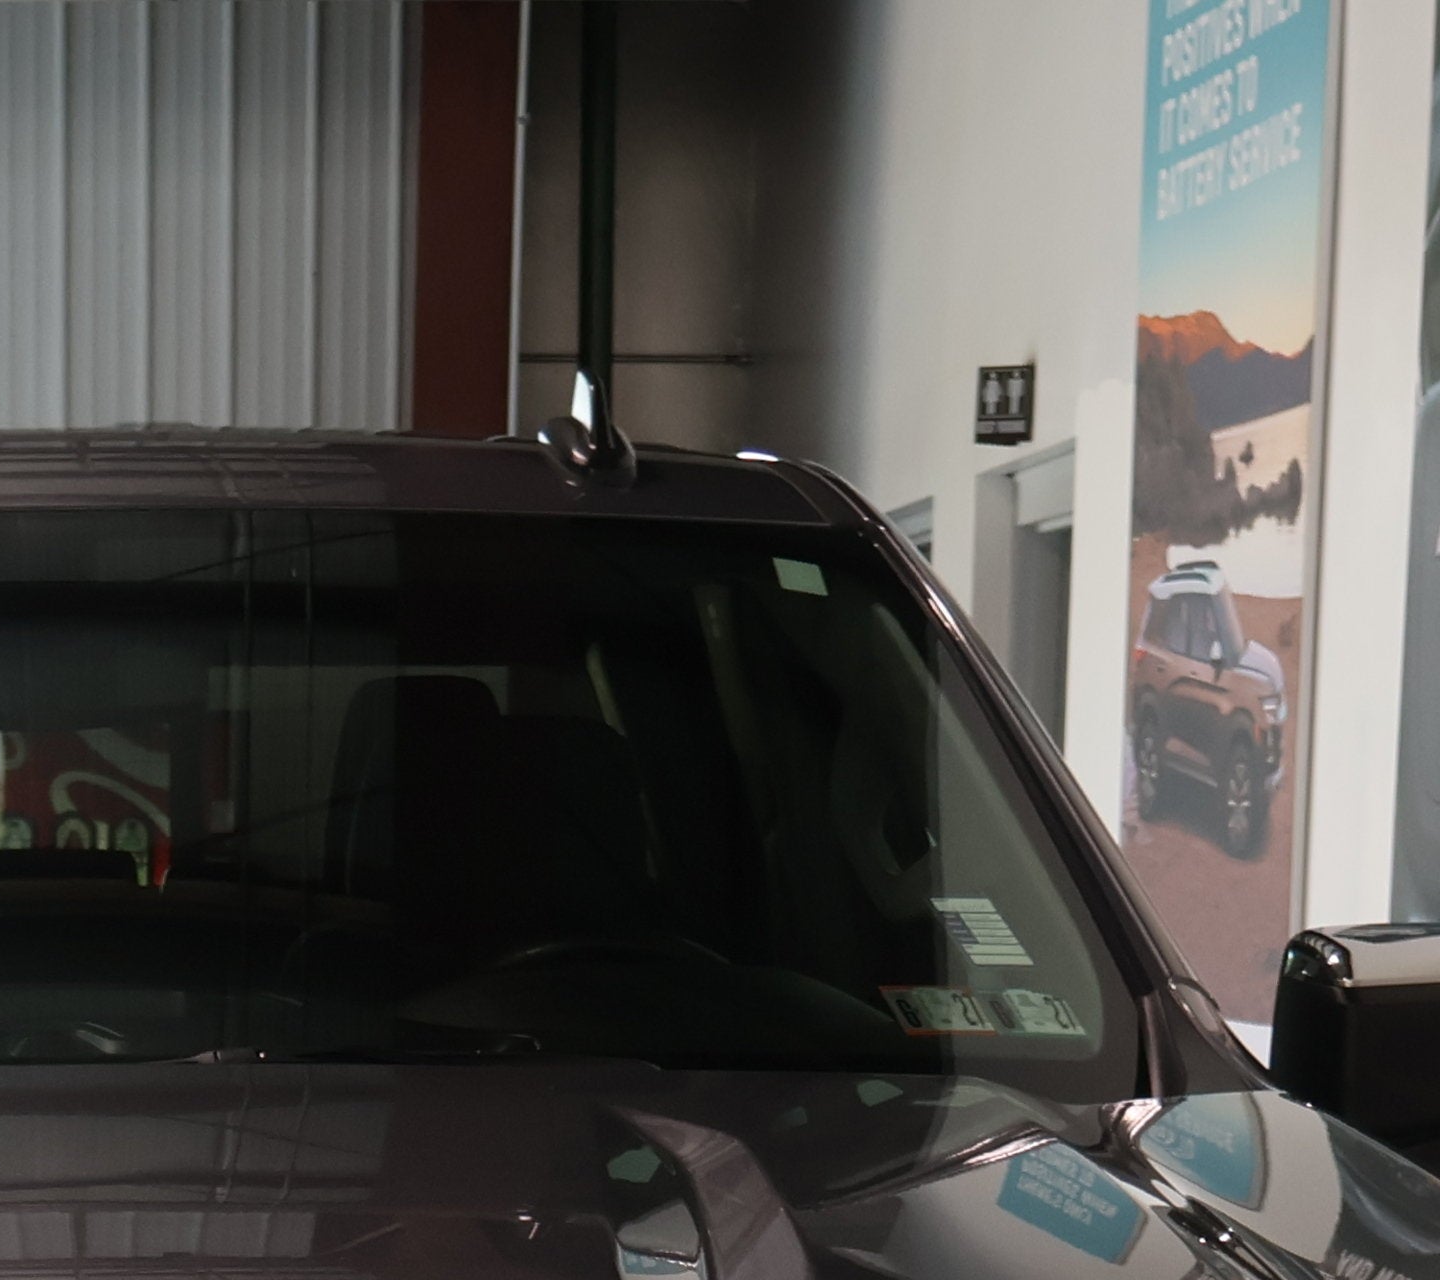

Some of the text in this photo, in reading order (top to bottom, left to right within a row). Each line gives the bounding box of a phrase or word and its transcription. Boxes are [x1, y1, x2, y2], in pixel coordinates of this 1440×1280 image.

[1161, 0, 1245, 86] POSITIVES
[1158, 54, 1259, 153] IT COMES TO
[1156, 102, 1304, 221] BATTERY SERVICE
